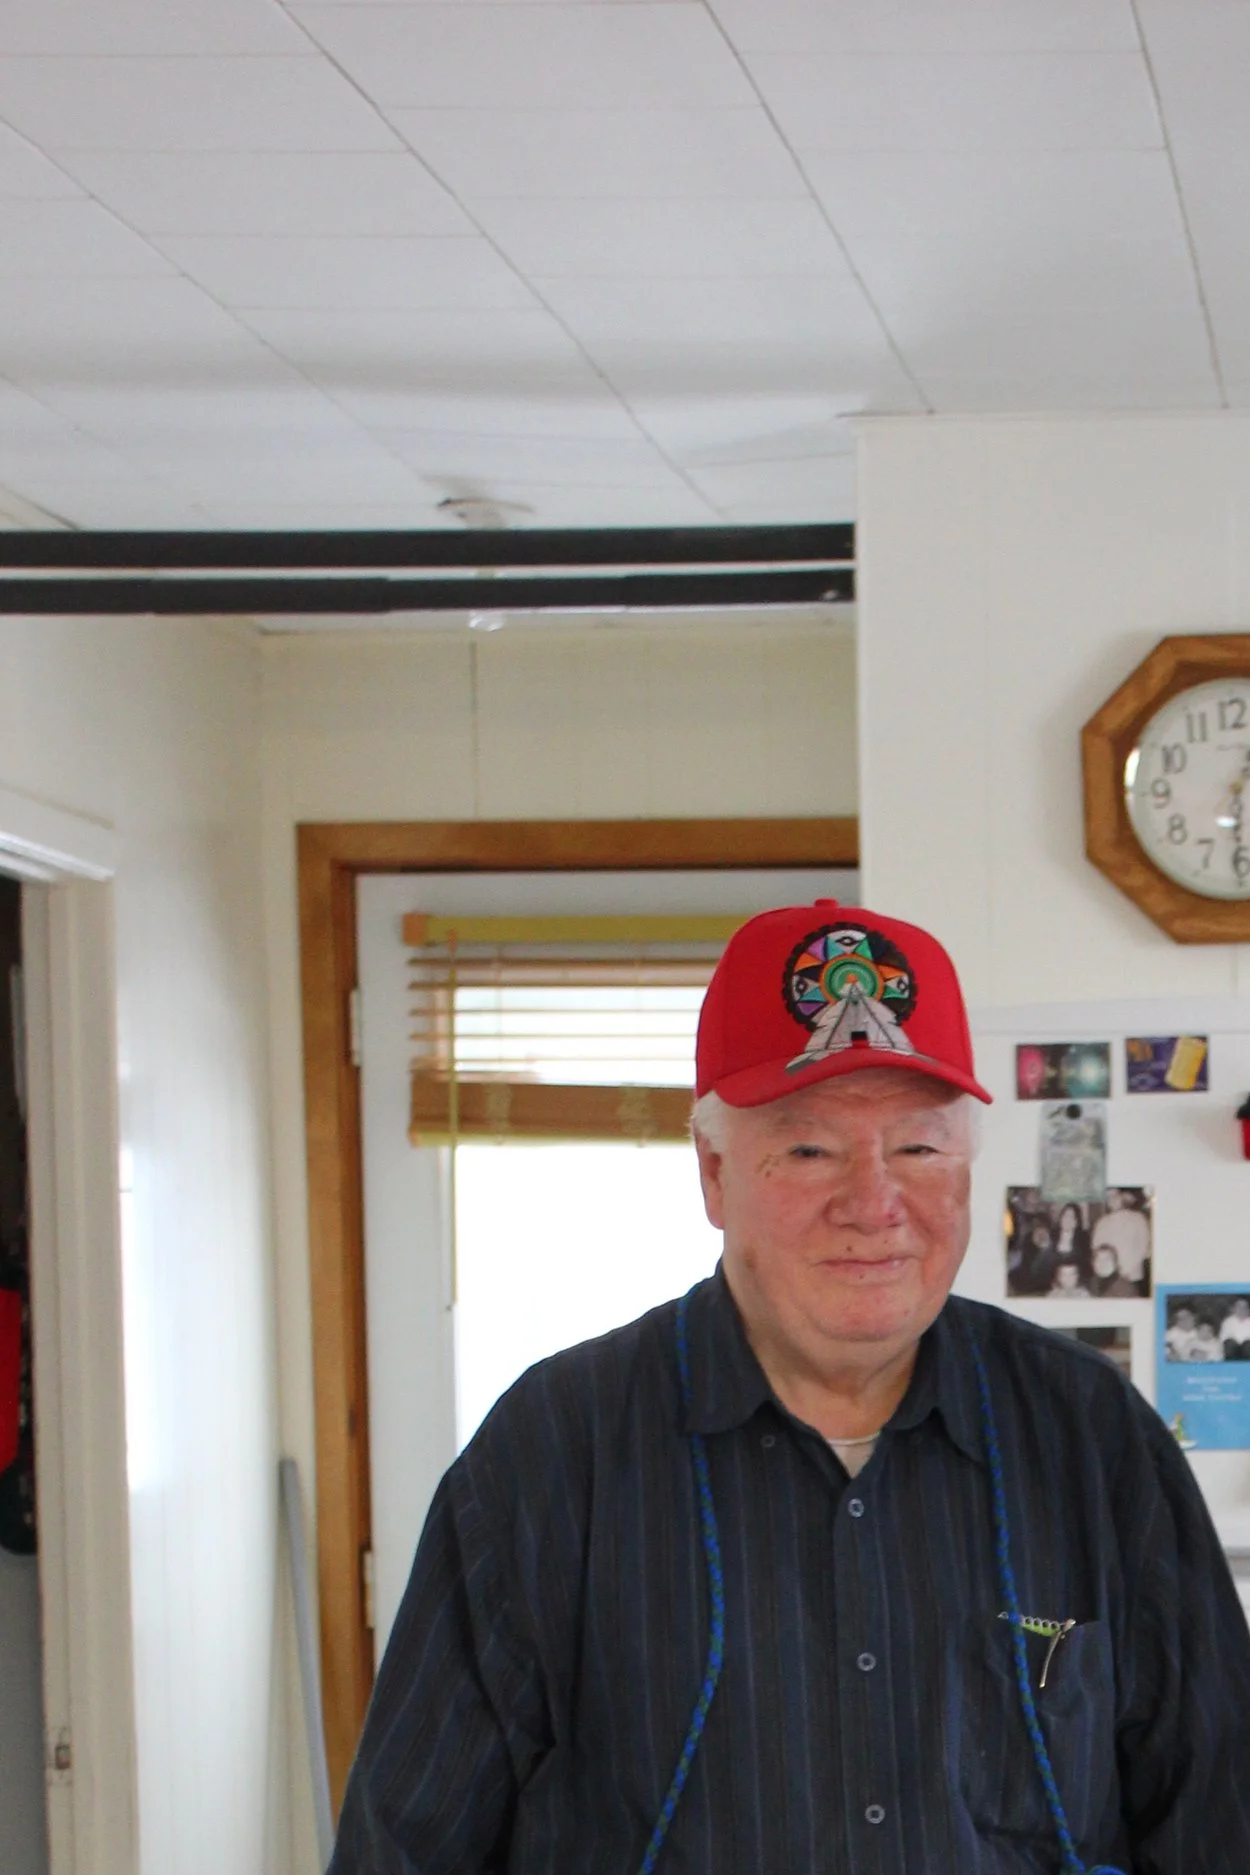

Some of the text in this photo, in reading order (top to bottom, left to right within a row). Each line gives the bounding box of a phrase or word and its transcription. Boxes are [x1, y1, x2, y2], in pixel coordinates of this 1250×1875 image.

[1185, 712, 1208, 743] 11
[1218, 698, 1247, 730] 12
[1162, 743, 1187, 774] 10
[1152, 778, 1172, 809] 9
[1168, 814, 1187, 845] 8
[1197, 838, 1215, 869] 7
